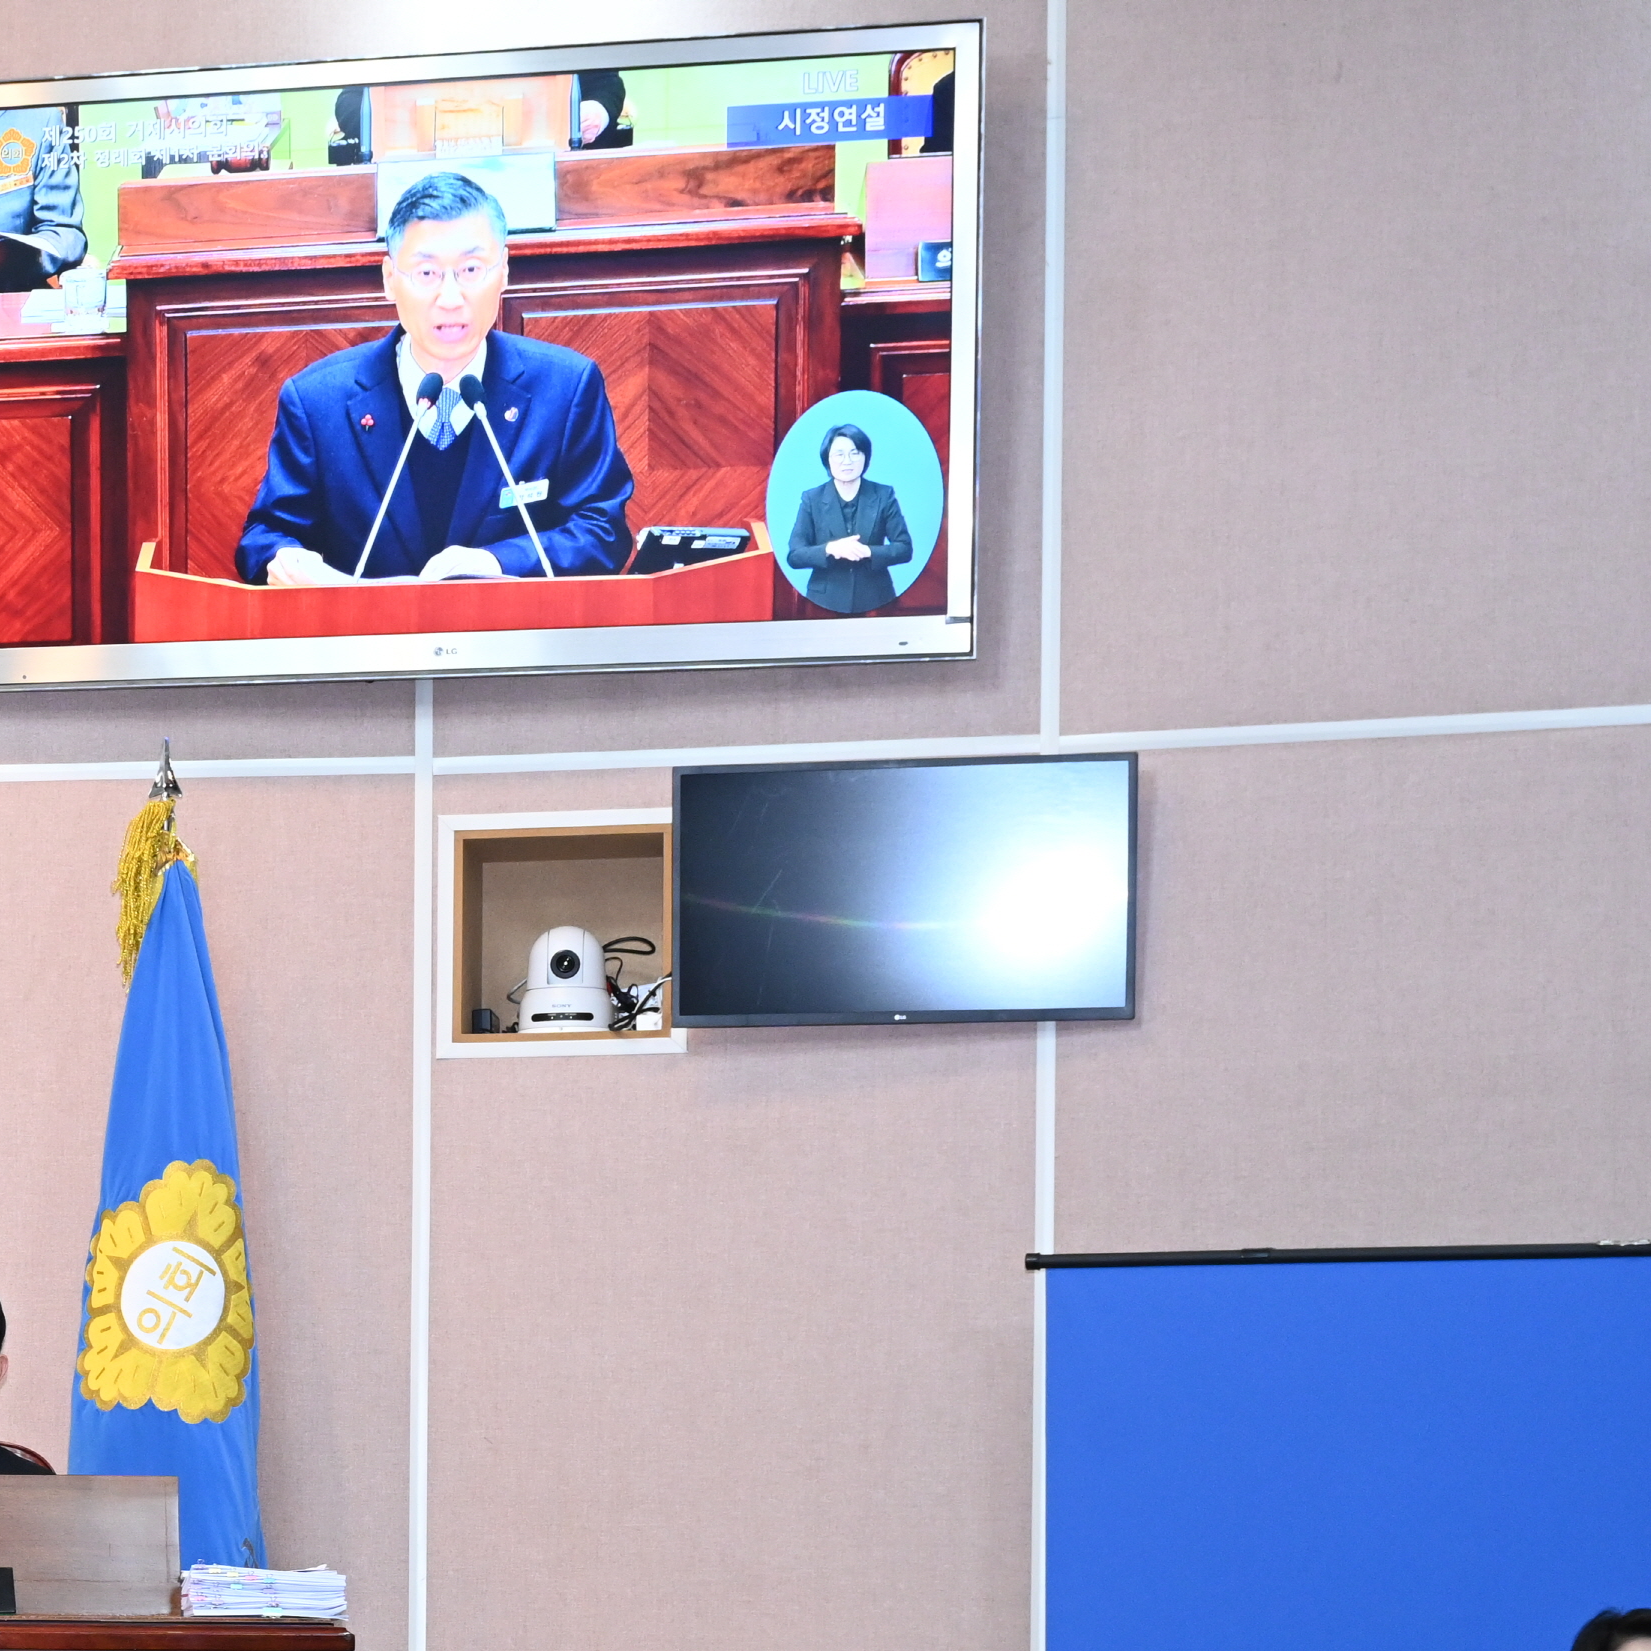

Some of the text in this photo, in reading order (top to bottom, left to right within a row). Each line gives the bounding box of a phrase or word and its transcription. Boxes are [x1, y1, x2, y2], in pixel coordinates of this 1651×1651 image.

[802, 69, 859, 94] LIVE
[41, 114, 228, 146] 제250회 거제시의회
[776, 103, 886, 136] 시정연설
[41, 150, 88, 171] 제2차
[137, 1246, 217, 1345] 의회
